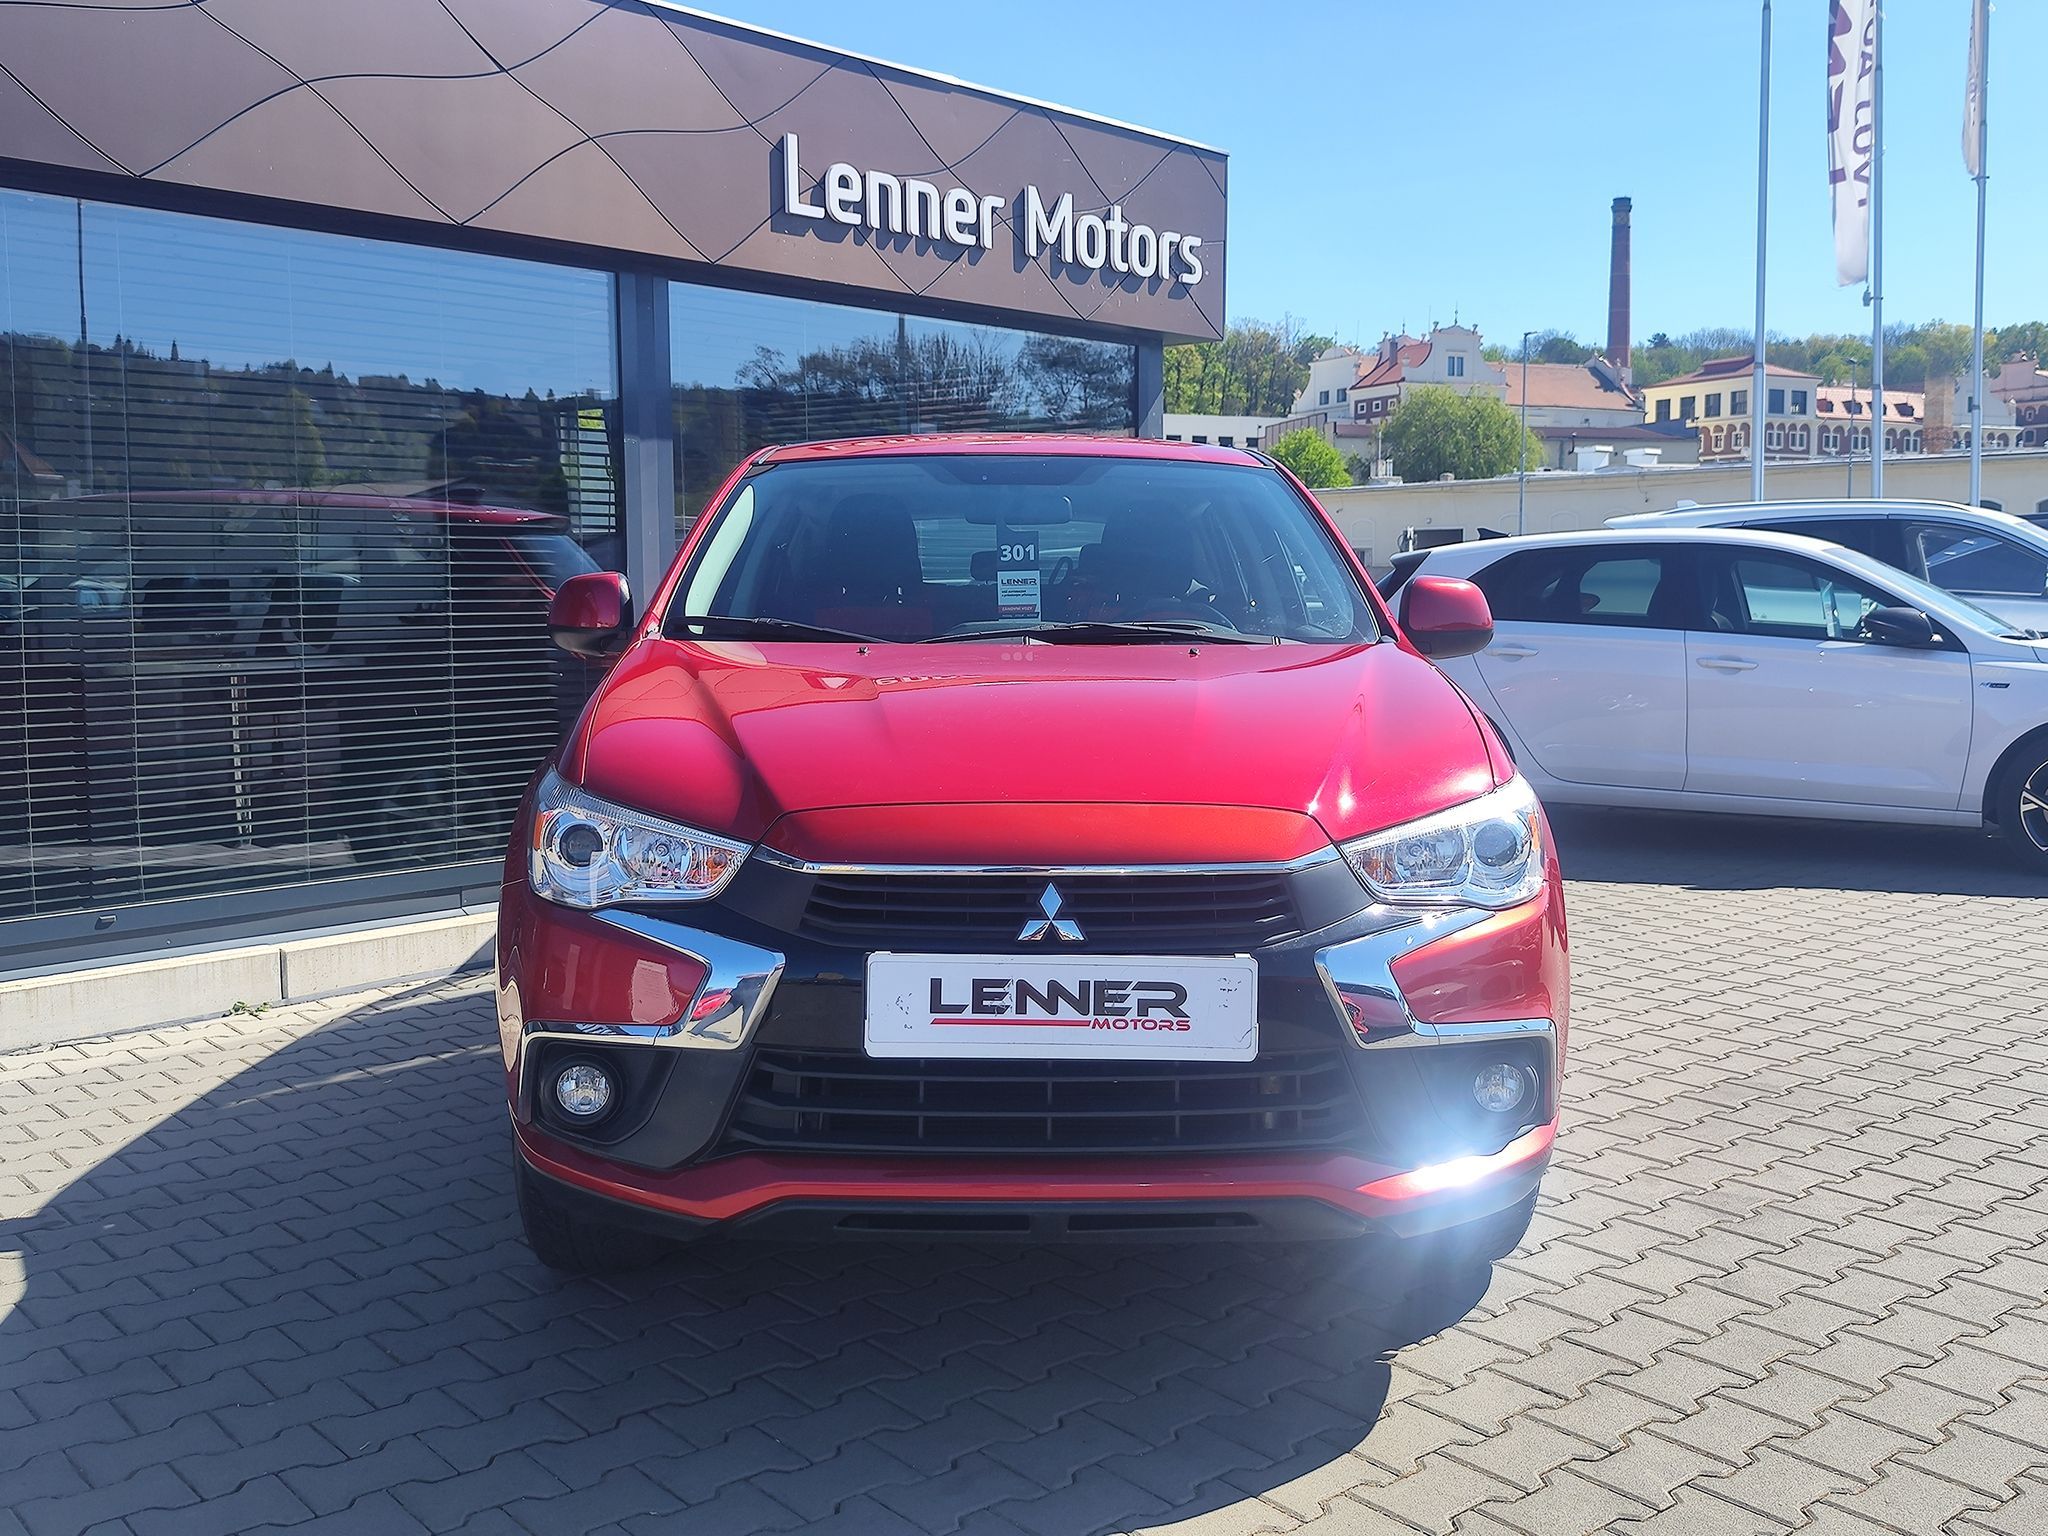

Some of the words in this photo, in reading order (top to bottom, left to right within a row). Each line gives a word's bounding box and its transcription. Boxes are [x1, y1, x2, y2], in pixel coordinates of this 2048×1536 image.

[783, 133, 1006, 250] Lenner
[1023, 185, 1204, 286] Motors
[1000, 544, 1035, 561] 301
[1001, 578, 1037, 586] LENNER
[929, 977, 1191, 1018] LENNER
[1091, 1017, 1191, 1032] MOTORS
